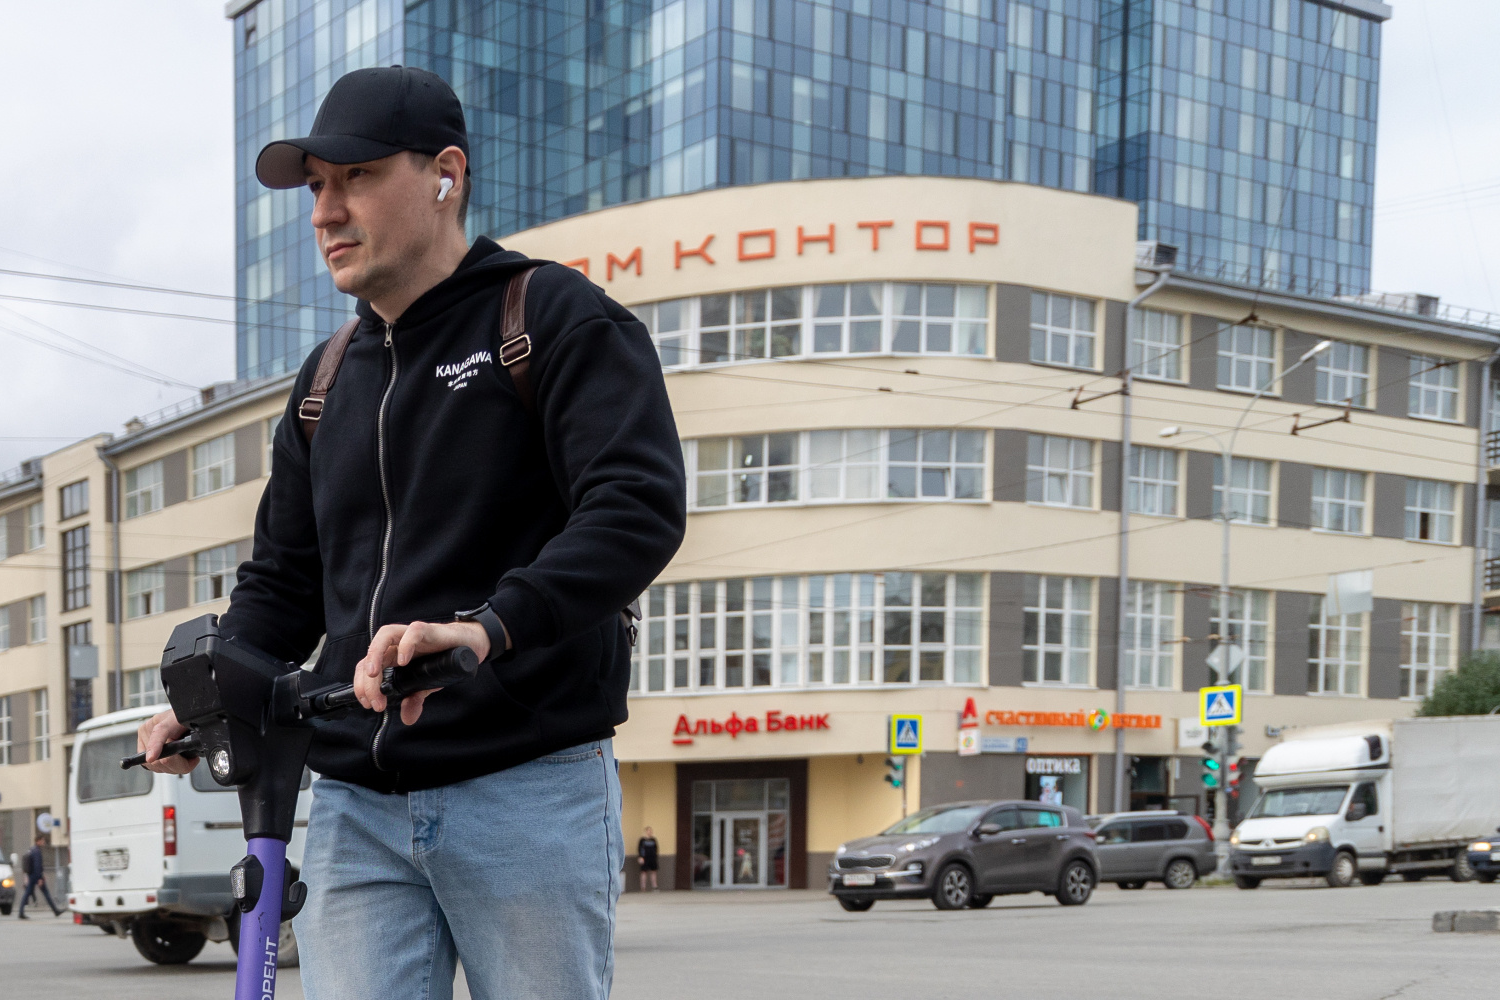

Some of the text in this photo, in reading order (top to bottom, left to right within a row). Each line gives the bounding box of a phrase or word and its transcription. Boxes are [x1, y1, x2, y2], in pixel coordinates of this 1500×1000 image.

[674, 219, 1000, 270] КОНТОР
[436, 350, 493, 378] KANAGAWA
[673, 709, 832, 743] Альфа Банк
